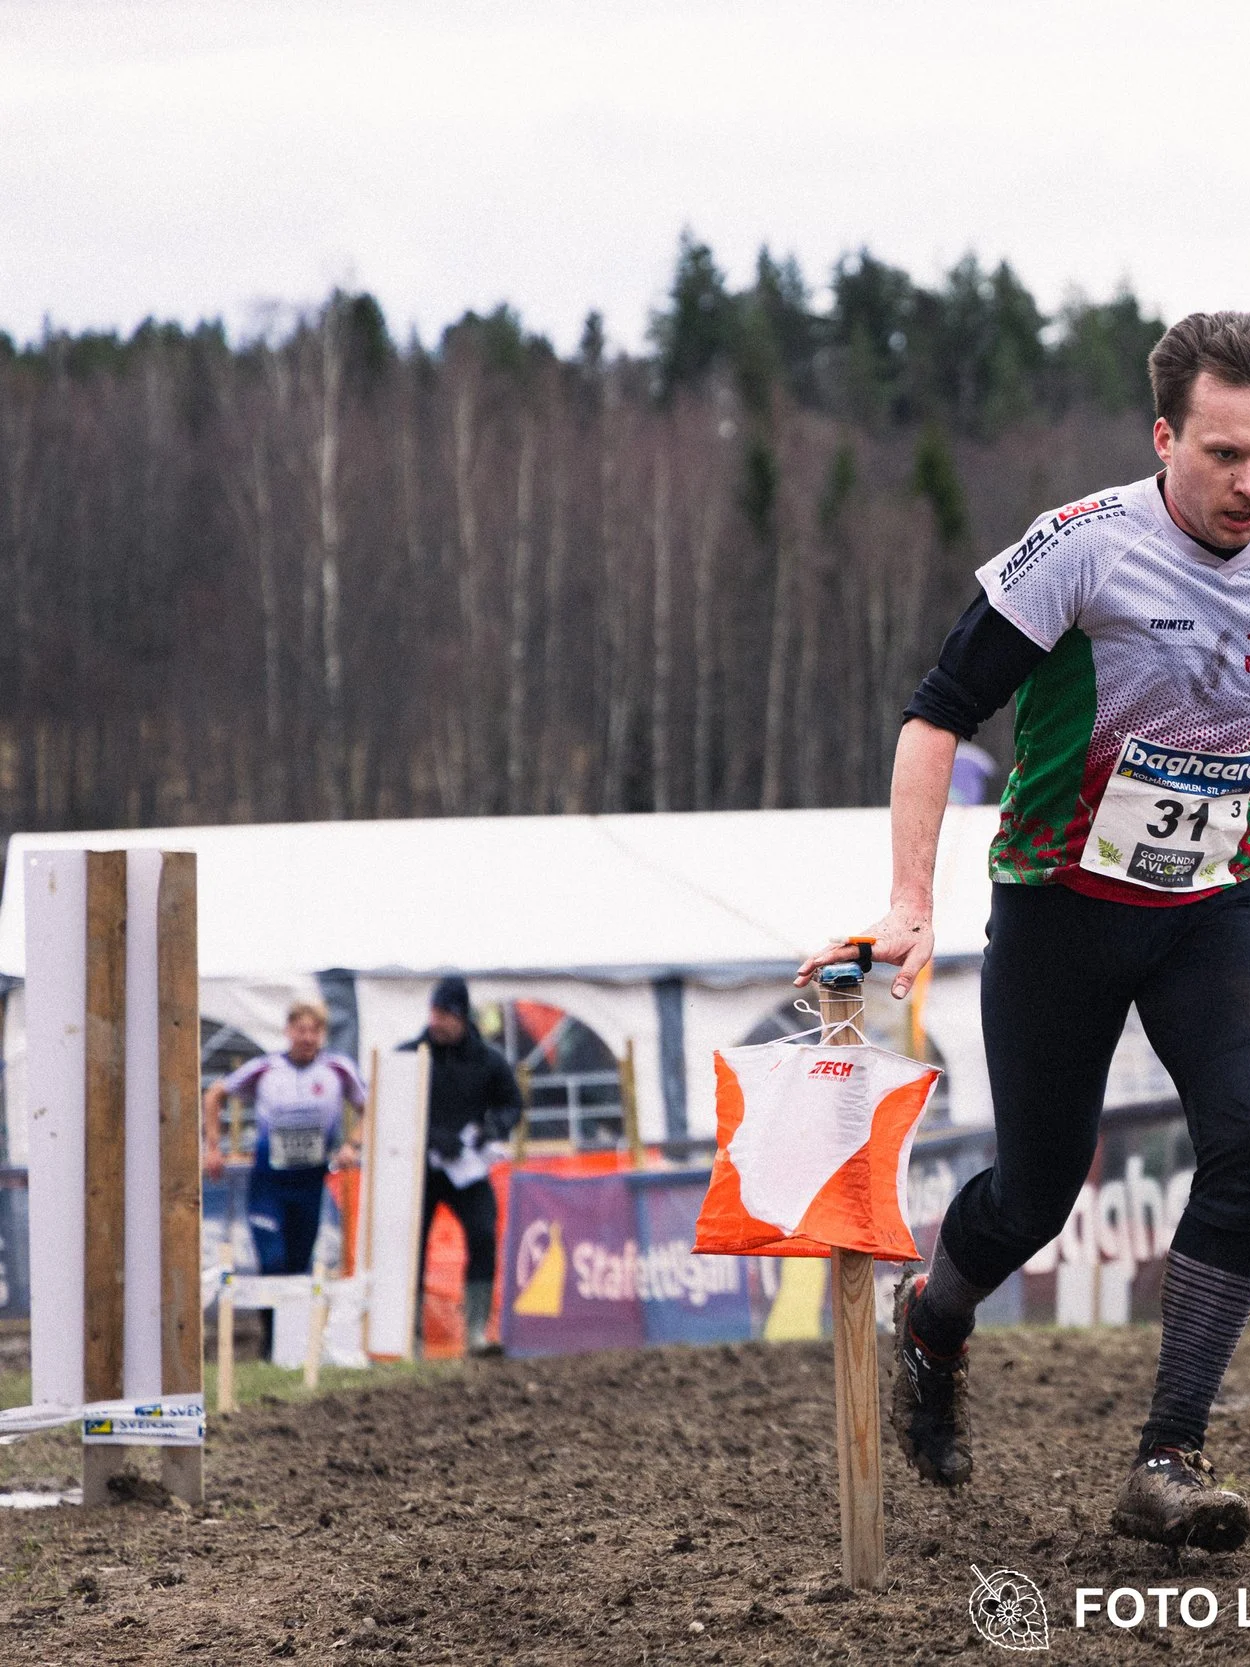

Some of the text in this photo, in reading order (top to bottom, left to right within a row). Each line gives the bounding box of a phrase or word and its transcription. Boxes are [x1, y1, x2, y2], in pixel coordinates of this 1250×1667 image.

[1003, 539, 1060, 593] MOUNTAIN
[1063, 517, 1091, 537] BIKE
[1150, 619, 1195, 631] TRIMTEX
[1133, 771, 1202, 793] KOLMÅRDSKAVLEN
[1207, 786, 1220, 796] STL
[1146, 799, 1241, 842] 31 3
[1141, 850, 1196, 866] GODKÄNDA
